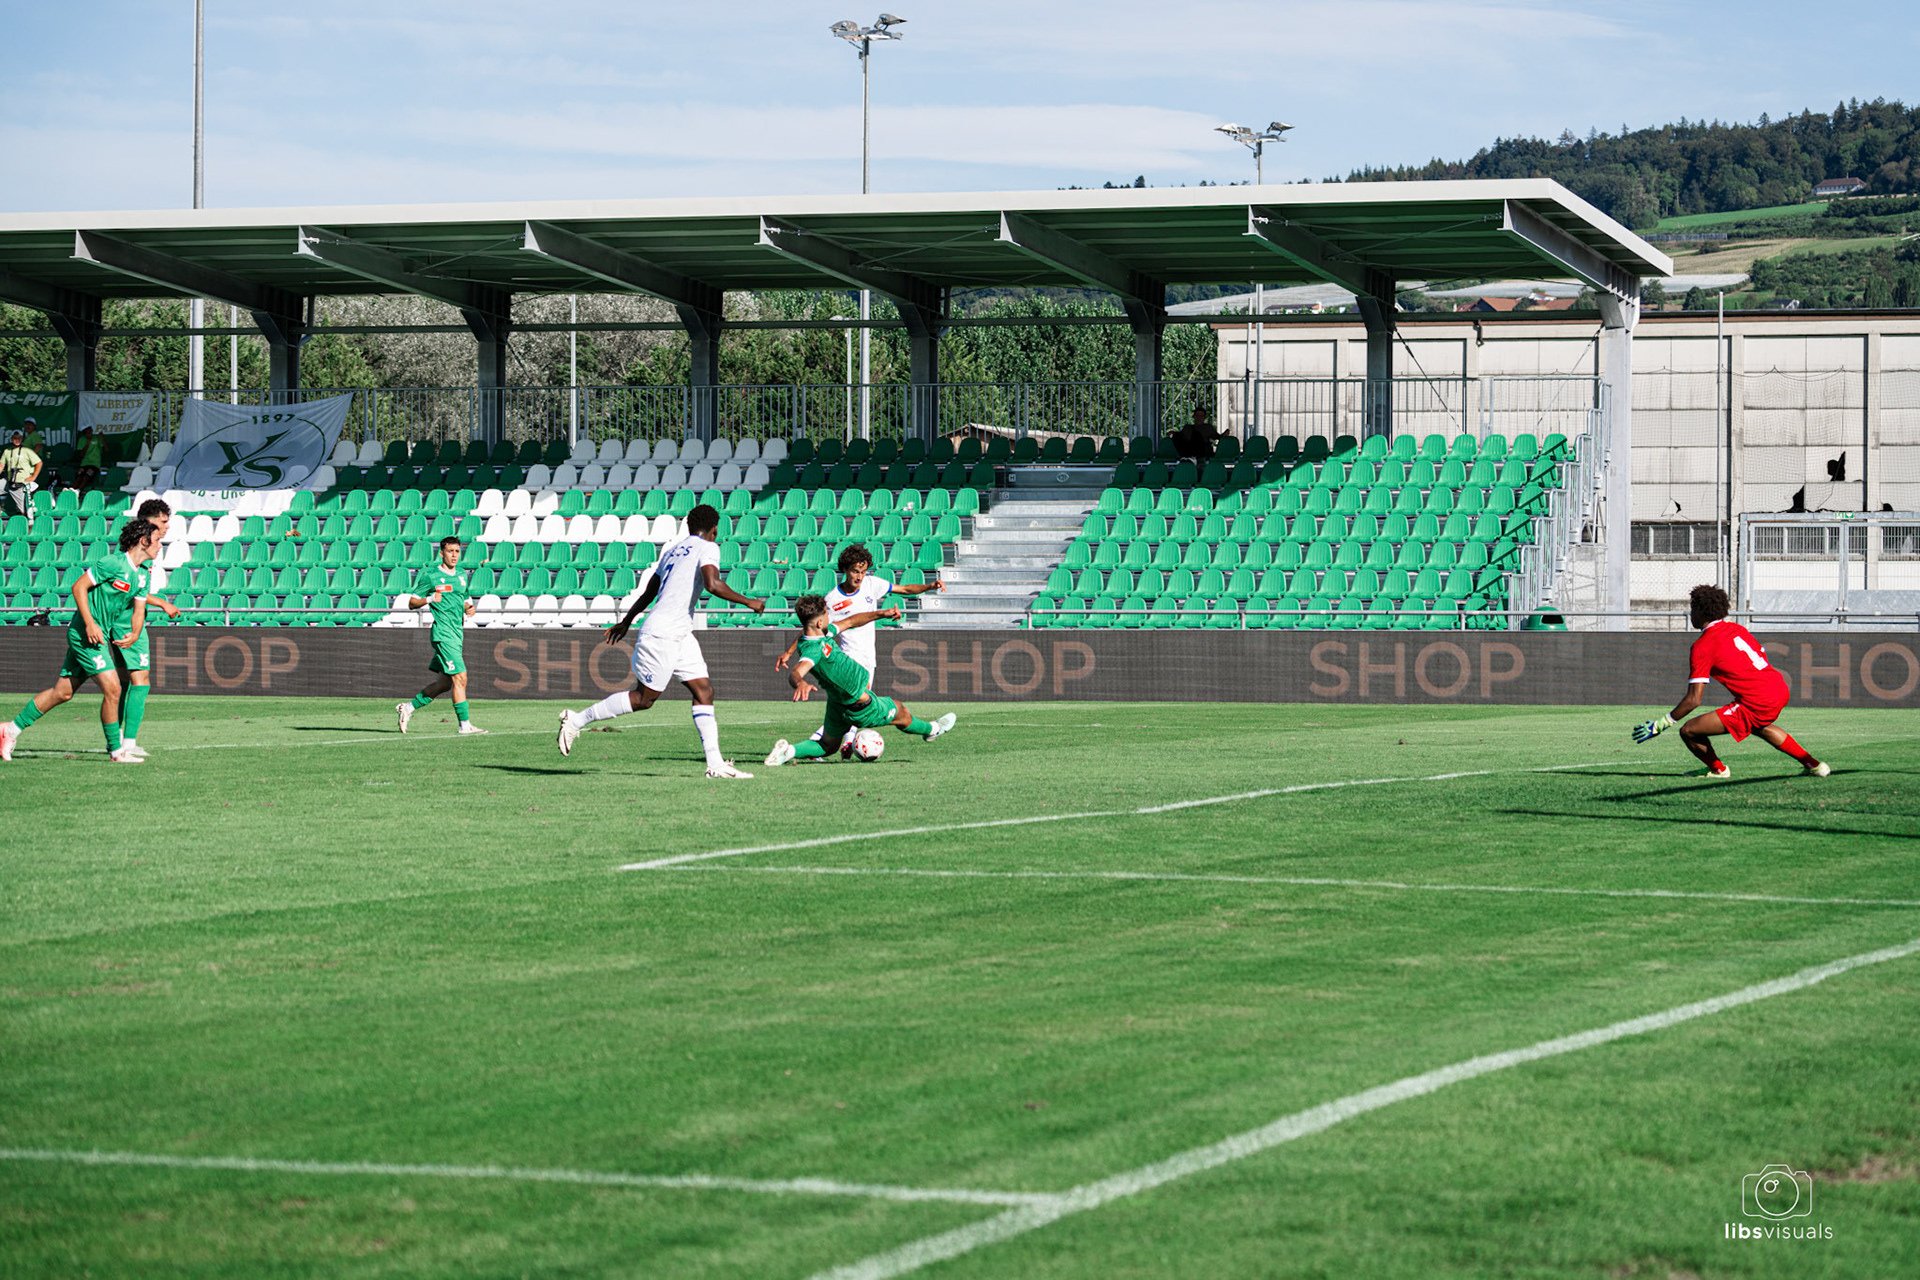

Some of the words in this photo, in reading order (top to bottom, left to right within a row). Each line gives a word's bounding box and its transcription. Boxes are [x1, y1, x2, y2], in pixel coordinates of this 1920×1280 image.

[96, 398, 143, 409] LIBERTE
[112, 411, 126, 422] ET
[252, 413, 295, 425] 1897
[95, 422, 134, 433] PATRIE
[156, 635, 300, 688] HOP
[493, 638, 638, 692] SHO
[891, 639, 1096, 695] SHOP
[1309, 640, 1526, 697] SHOP
[1733, 636, 1769, 671] 1
